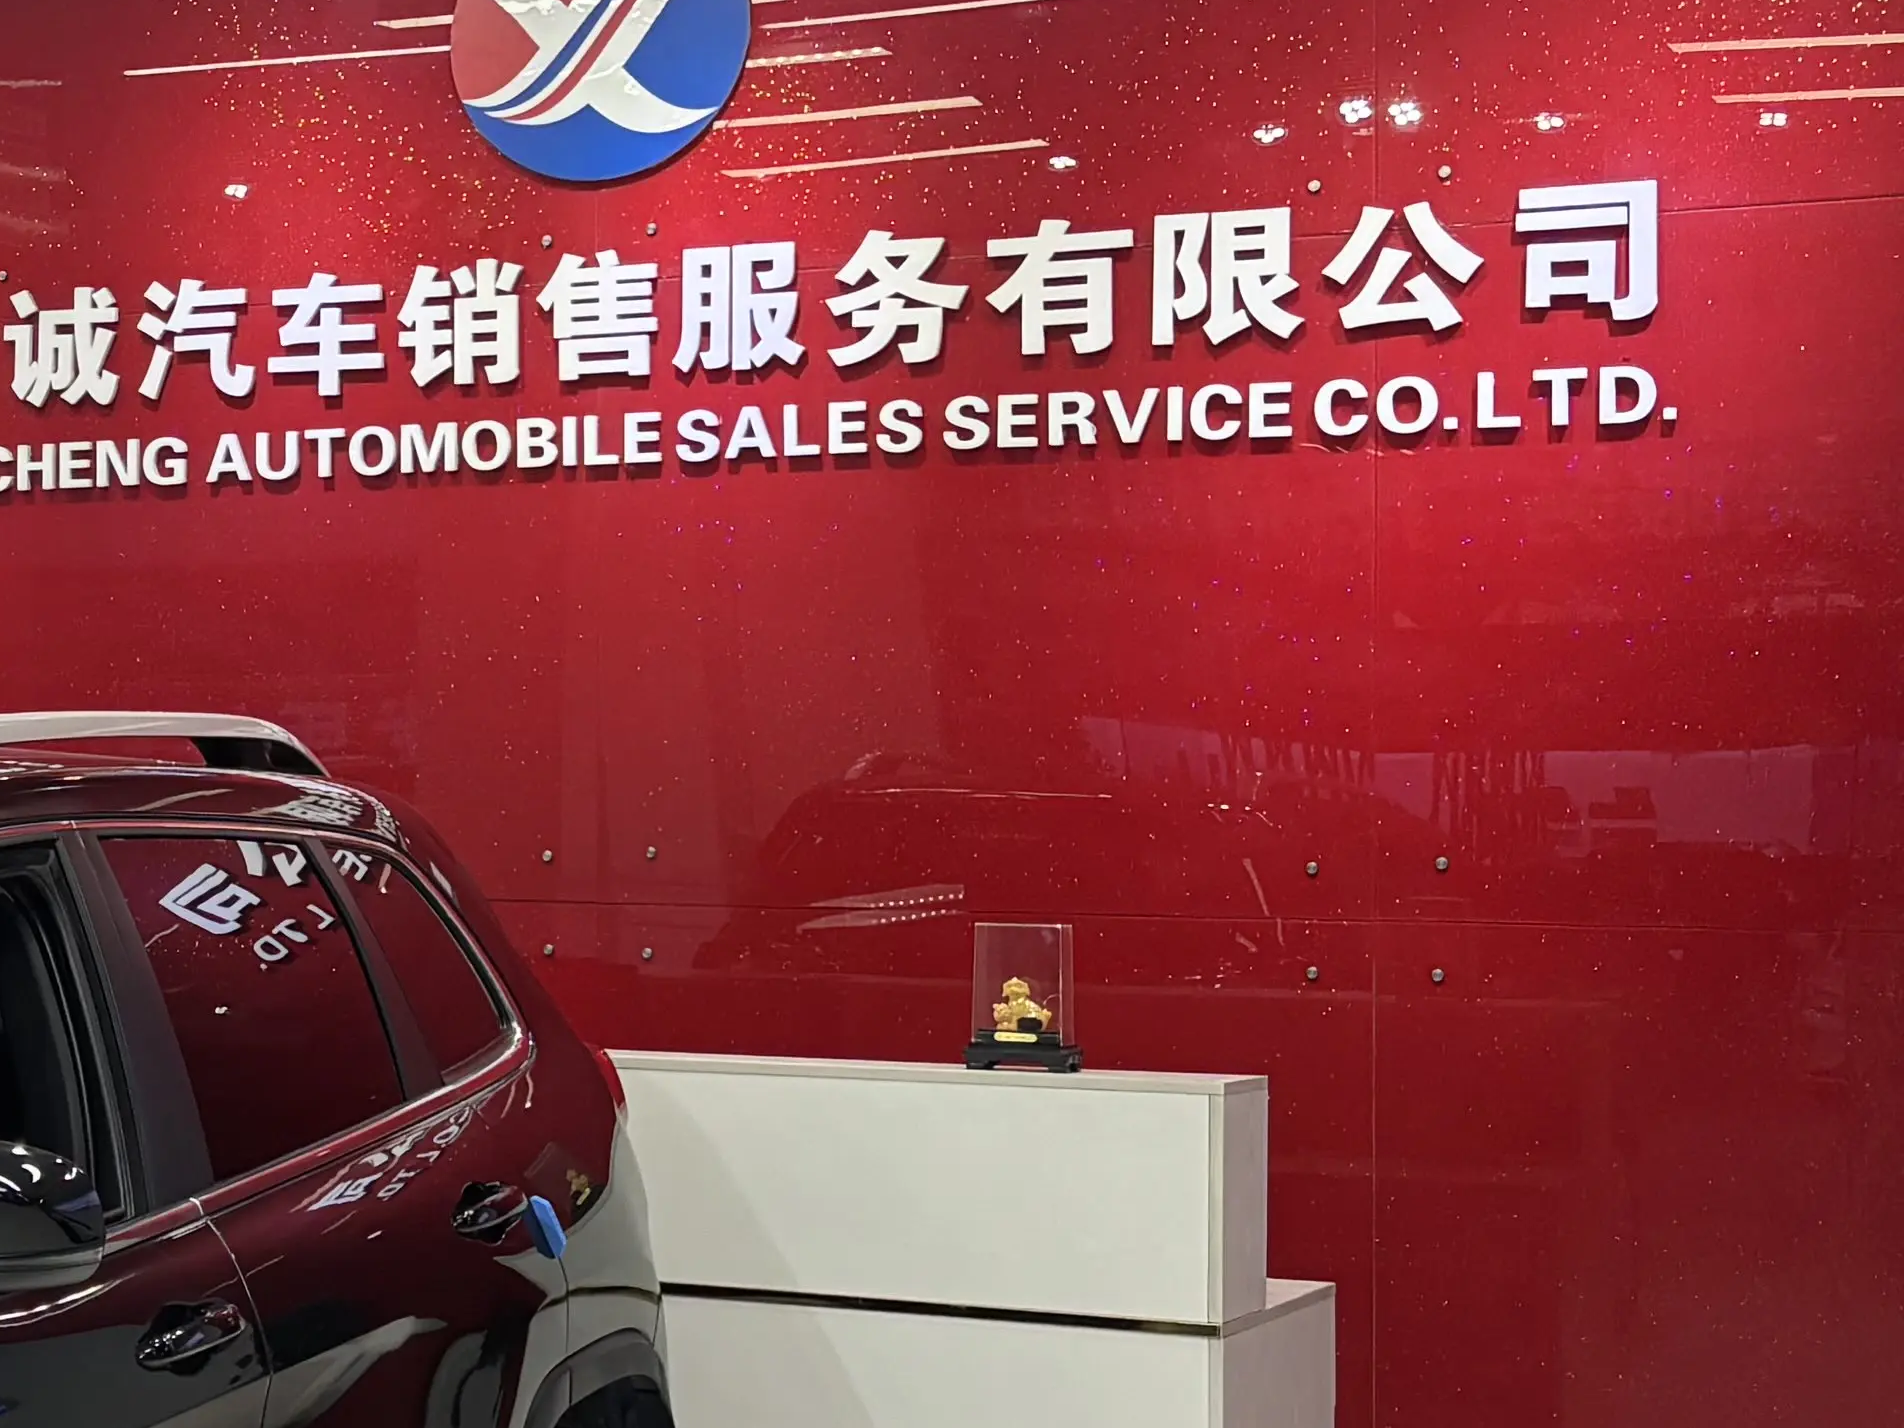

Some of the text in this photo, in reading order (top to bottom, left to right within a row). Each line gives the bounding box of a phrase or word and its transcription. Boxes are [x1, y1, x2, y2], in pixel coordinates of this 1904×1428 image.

[204, 410, 663, 485] AUTOMOBILE
[675, 397, 923, 463] SALES
[943, 380, 1293, 452] SERVICE
